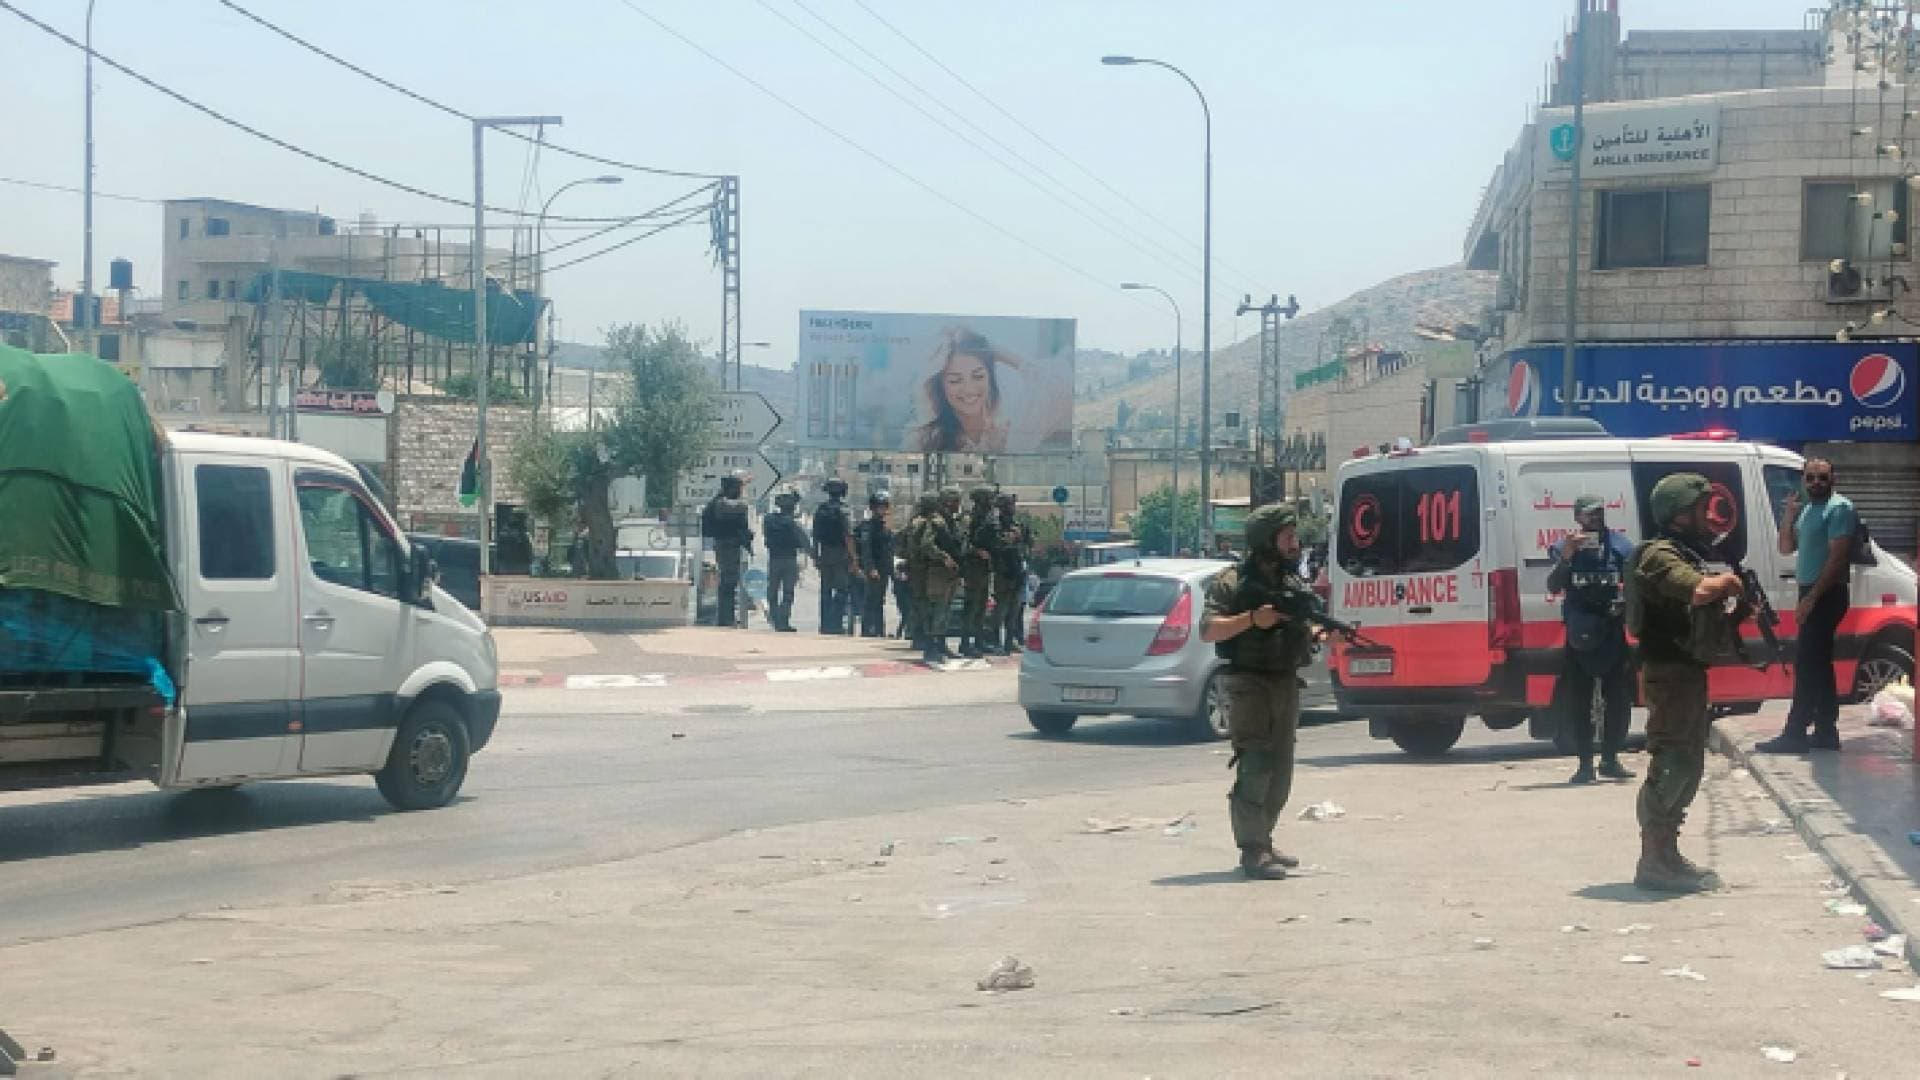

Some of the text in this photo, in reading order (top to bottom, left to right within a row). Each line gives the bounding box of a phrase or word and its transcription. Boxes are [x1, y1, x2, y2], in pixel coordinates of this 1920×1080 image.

[1733, 379, 1842, 408] مطعم
[1850, 413, 1902, 432] pepsi
[1417, 489, 1461, 543] 101
[523, 590, 568, 603] USAID
[1344, 574, 1458, 608] AMBULANCE
